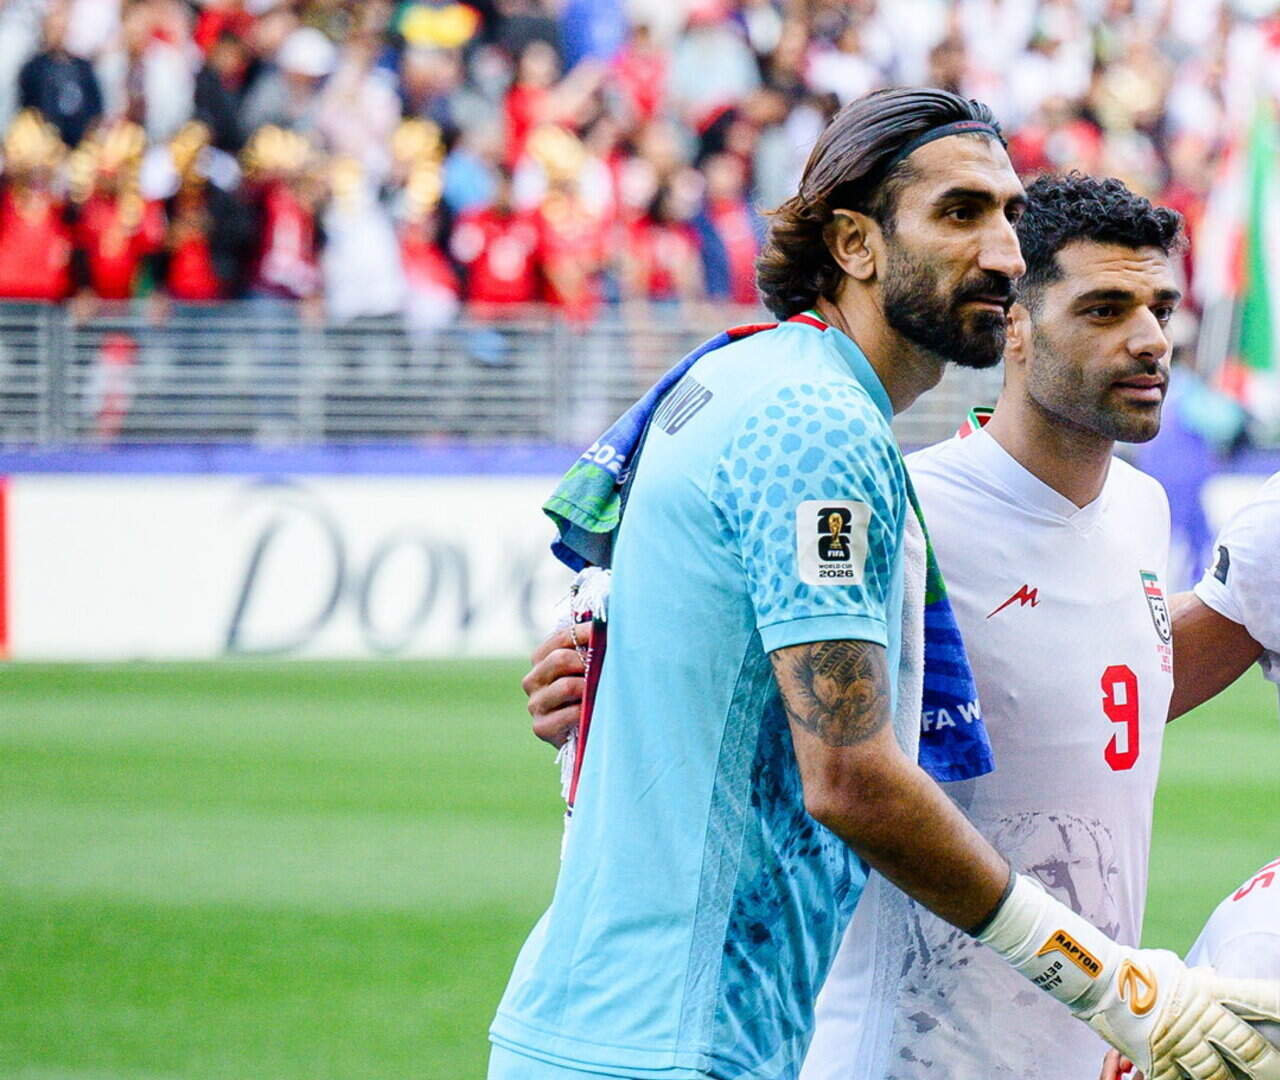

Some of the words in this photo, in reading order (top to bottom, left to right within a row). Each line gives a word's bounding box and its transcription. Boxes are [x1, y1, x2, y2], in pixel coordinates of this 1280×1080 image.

[827, 550, 846, 558] FIFA
[818, 569, 855, 578] 2026
[1100, 664, 1139, 771] 9
[1055, 934, 1100, 974] RAPTOR
